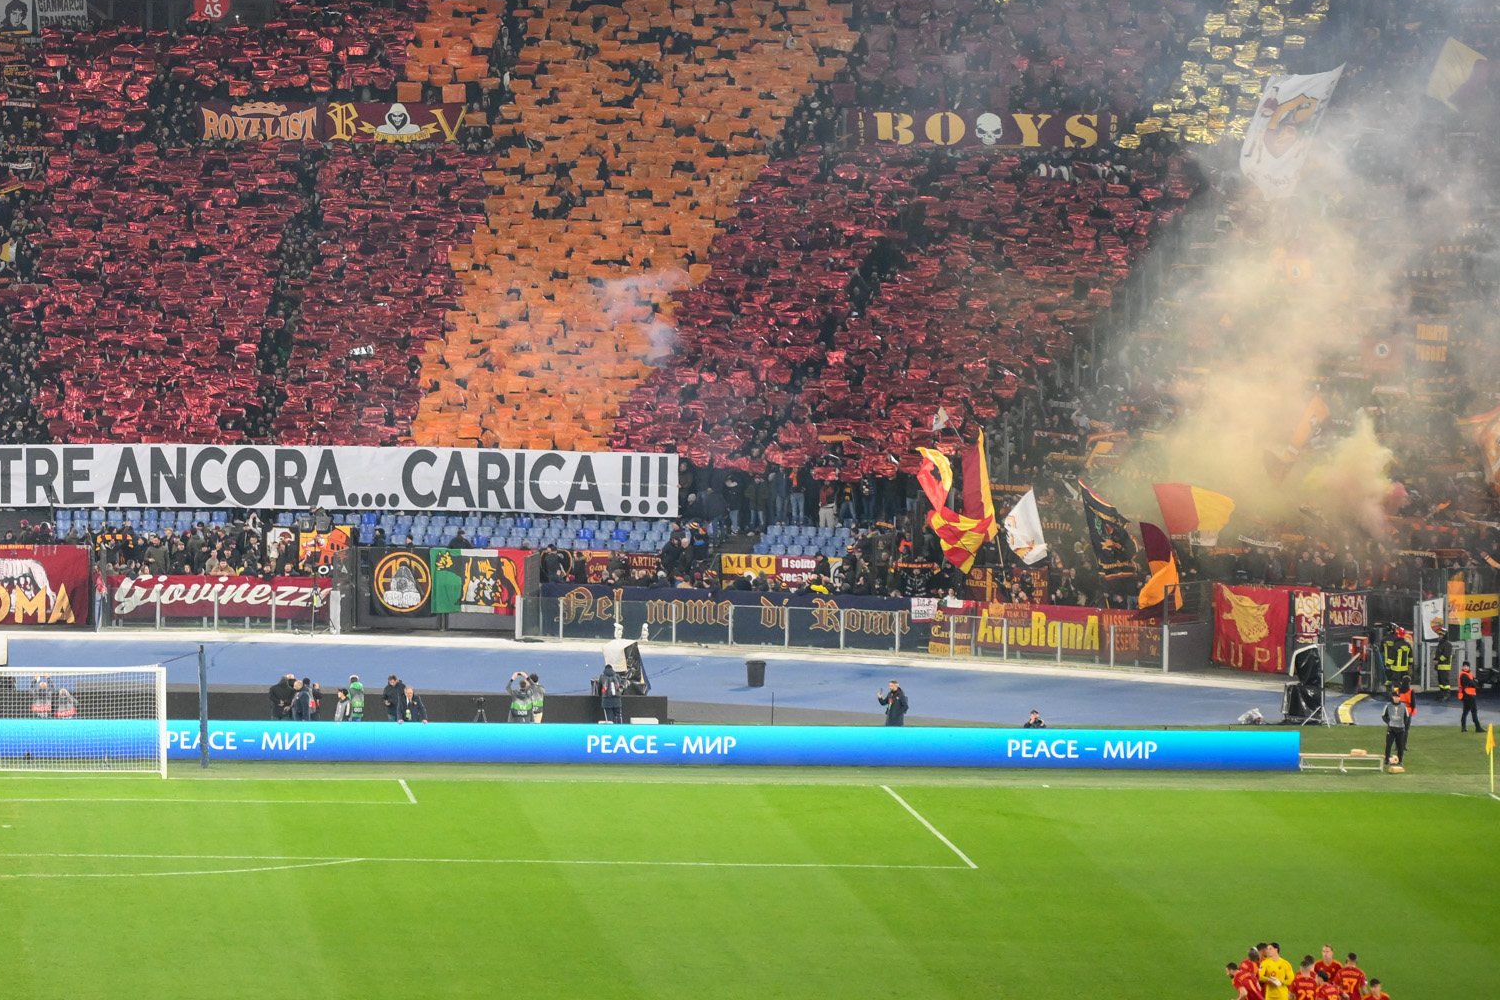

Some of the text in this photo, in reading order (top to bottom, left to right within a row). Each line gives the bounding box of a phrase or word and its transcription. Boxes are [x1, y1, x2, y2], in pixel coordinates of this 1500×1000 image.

[204, 3, 222, 18] AS
[723, 555, 774, 570] MIO
[789, 558, 816, 569] solito
[646, 598, 735, 627] nome
[760, 595, 789, 630] di
[808, 597, 911, 636] Roma
[934, 610, 968, 625] Grppo
[1105, 632, 1140, 652] PESENTE
[1215, 637, 1283, 671] LUPI
[167, 731, 237, 750] PEACE
[261, 732, 316, 751] МИР
[587, 734, 659, 754] PEACE
[682, 735, 737, 755] МИР
[1007, 739, 1079, 759] PEACE
[1103, 740, 1158, 759] МИР
[1342, 978, 1358, 994] 37
